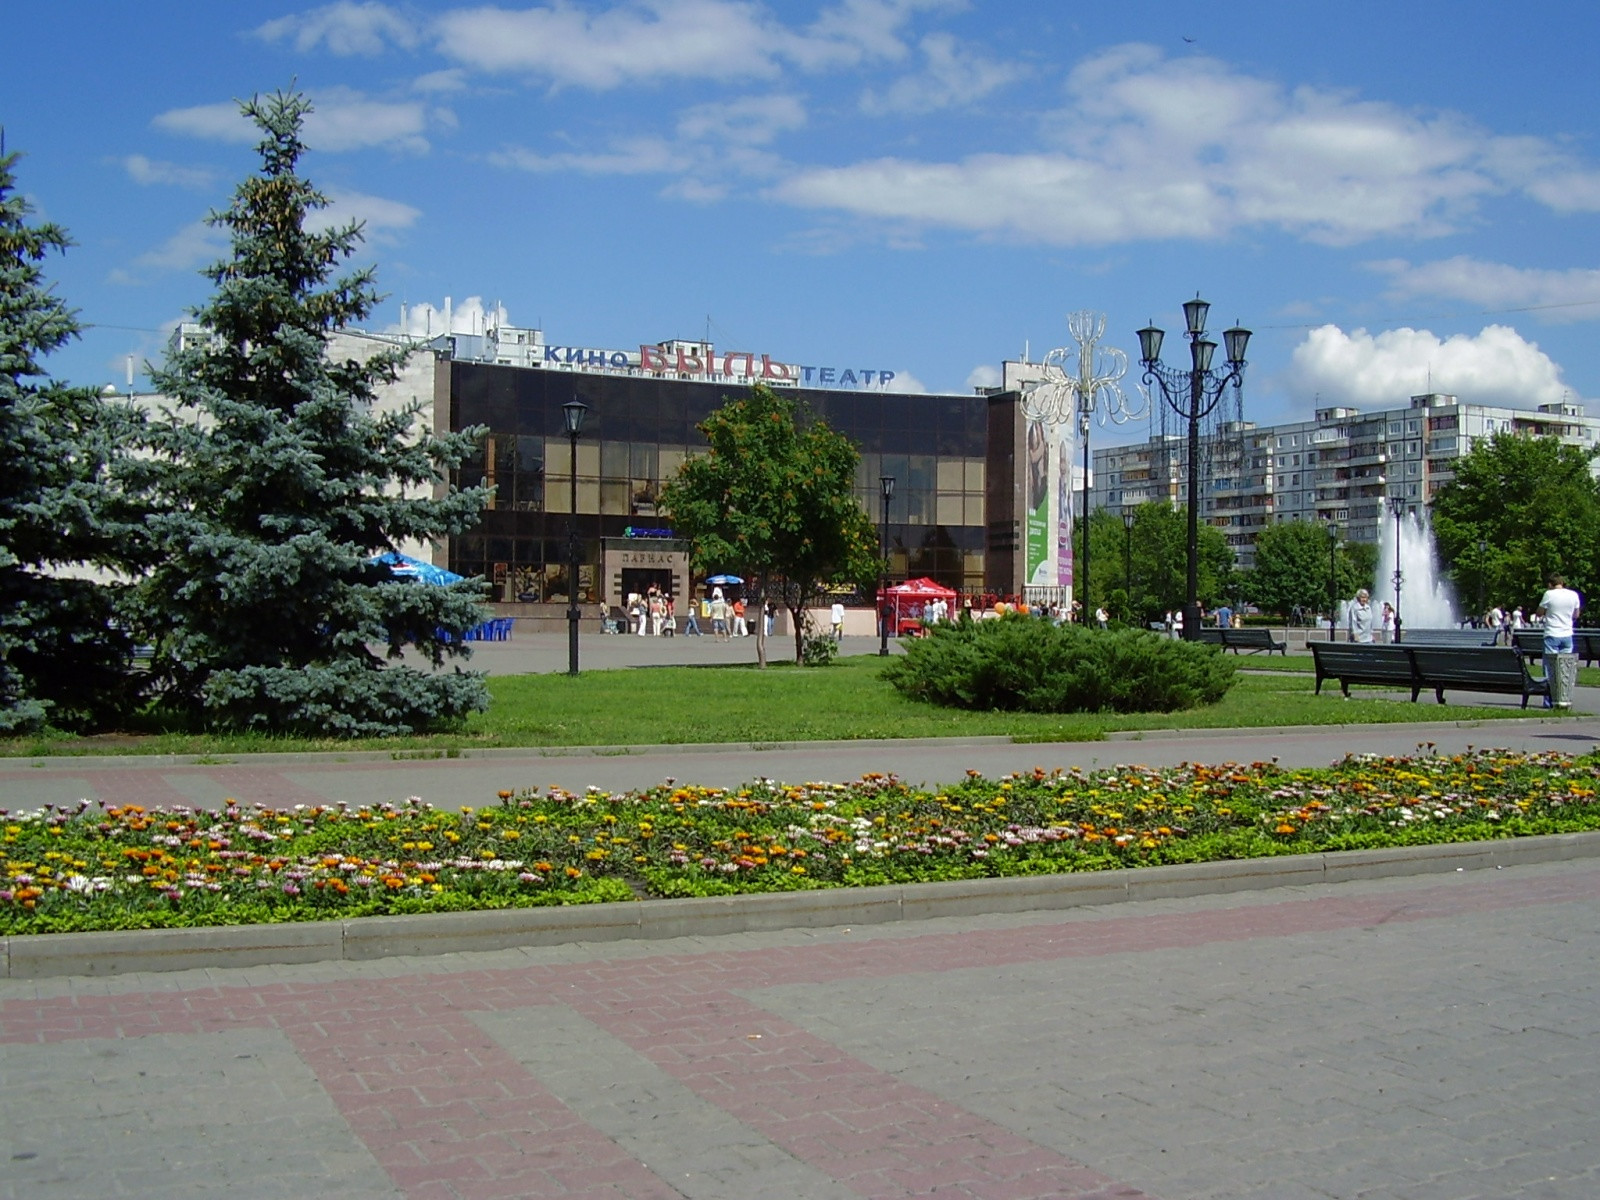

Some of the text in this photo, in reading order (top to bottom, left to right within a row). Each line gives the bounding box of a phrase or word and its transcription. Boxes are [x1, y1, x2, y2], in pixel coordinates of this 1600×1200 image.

[544, 345, 628, 368] КИНО
[800, 365, 896, 386] ТЕАТР
[621, 553, 674, 564] ПАРНАС
